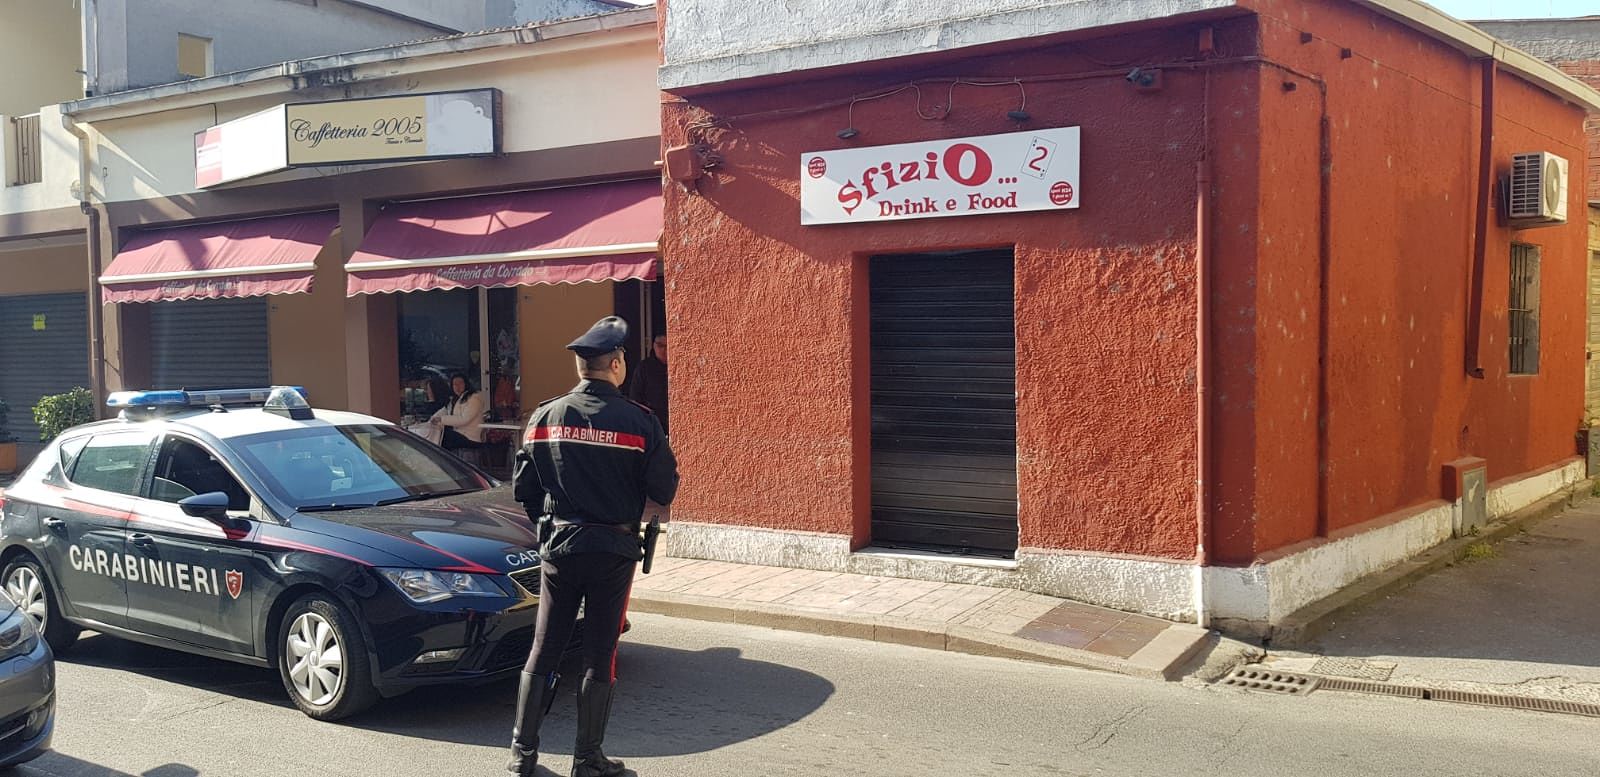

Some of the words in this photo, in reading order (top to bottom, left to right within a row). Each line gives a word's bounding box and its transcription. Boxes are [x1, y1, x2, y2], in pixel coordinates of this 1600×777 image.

[290, 118, 368, 148] Caffetteria
[371, 116, 423, 137] 2005
[1029, 146, 1048, 171] 2
[878, 197, 939, 217] Drink
[946, 199, 957, 211] e
[967, 192, 1018, 210] Food
[436, 265, 481, 280] Caffetteria
[483, 265, 496, 279] da
[498, 263, 534, 278] Corrado
[551, 426, 618, 444] CARABINIERI
[69, 544, 220, 596] CARABINIERI
[505, 549, 542, 566] CAR
